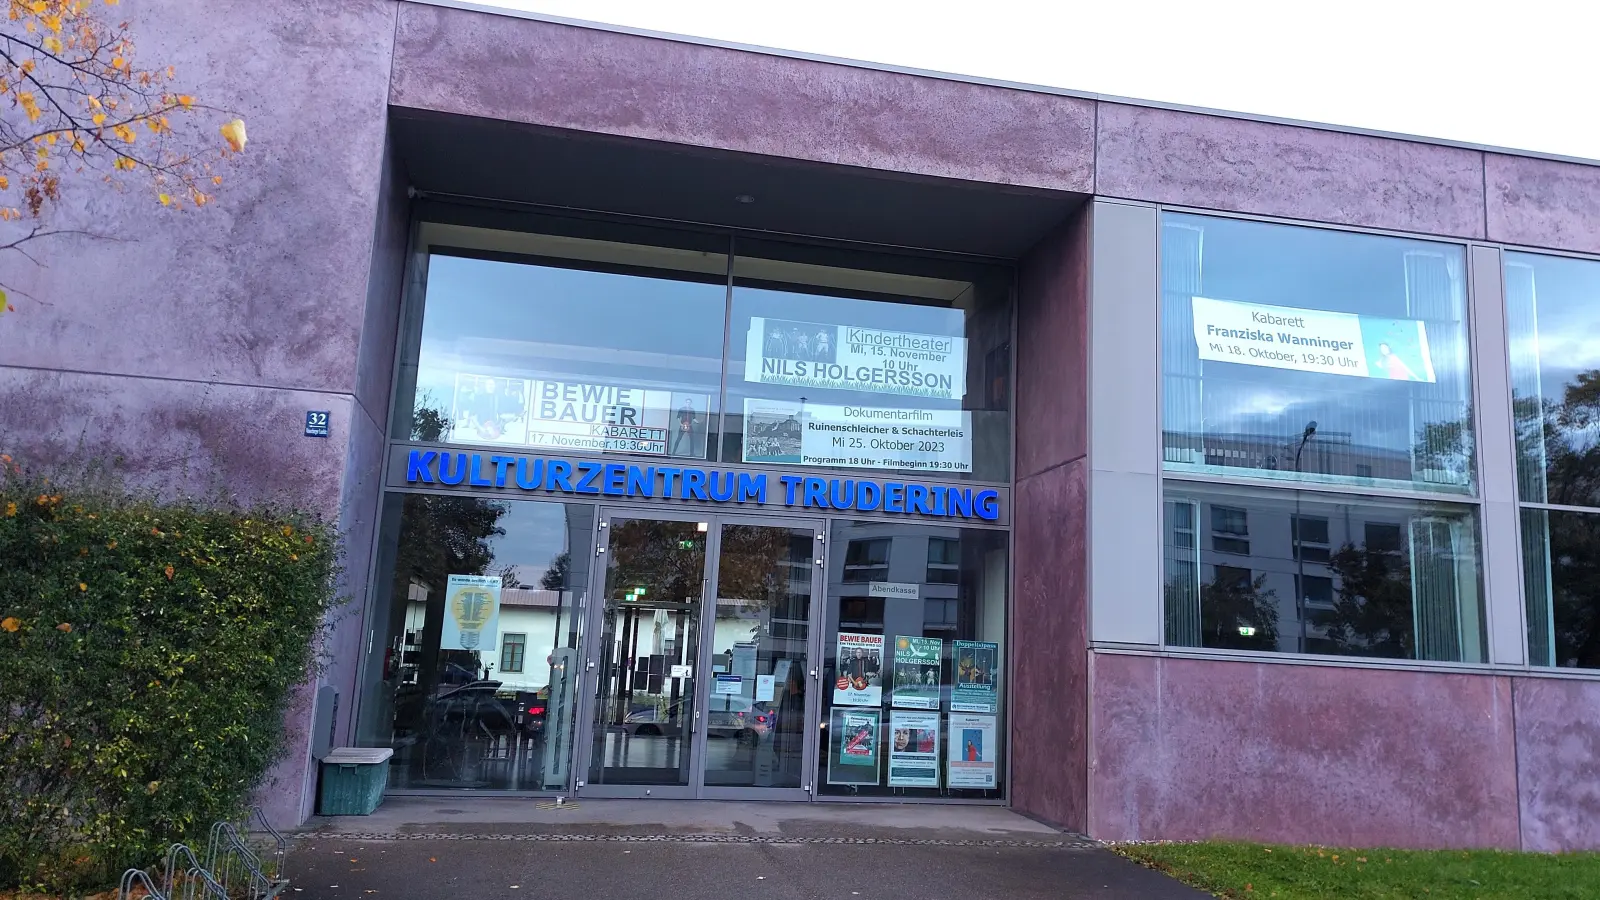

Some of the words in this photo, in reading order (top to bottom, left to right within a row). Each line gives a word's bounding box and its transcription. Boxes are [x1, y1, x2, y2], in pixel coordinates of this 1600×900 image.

[1251, 311, 1305, 329] Kabarett
[849, 328, 950, 352] Kindertheater
[1206, 324, 1274, 343] Franziska
[1277, 332, 1354, 352] Wanninger
[850, 344, 868, 357] Mi,
[871, 346, 889, 358] 15.
[890, 348, 947, 363] November
[1209, 342, 1224, 354] Mi
[1228, 344, 1245, 357] 18.
[1248, 347, 1298, 364] Oktober,
[1302, 353, 1334, 367] 19:30
[1337, 356, 1359, 369] Uhr
[761, 357, 807, 377] NILS
[813, 362, 952, 390] HOLGERSSON
[882, 359, 896, 371] 10
[898, 361, 918, 372] Uhr
[542, 381, 632, 407] BEWIE
[308, 412, 326, 426] 32
[540, 400, 637, 426] BAUER
[843, 406, 933, 421] Dokumentarfilm
[591, 424, 665, 440] KABARETT
[808, 422, 889, 435] Ruinenschleicher
[892, 427, 899, 435] &
[902, 427, 964, 438] Schachterleis
[531, 433, 548, 445] 17.
[832, 437, 845, 448] Mi
[848, 437, 867, 449] 25.
[870, 438, 914, 451] Oktober
[918, 441, 945, 453] 2023
[803, 456, 846, 467] Programm
[849, 457, 859, 466] 18
[860, 458, 876, 466] Uhr
[883, 459, 927, 470] Filmbeginn
[929, 462, 953, 470] 19:30
[954, 463, 969, 471] Uhr
[406, 450, 767, 504] KULTURZENTRUM
[780, 475, 999, 521] TRUDERING
[871, 584, 917, 595] Abendkasse
[861, 636, 882, 644] BAUER
[895, 657, 940, 666] HOLGERSSON
